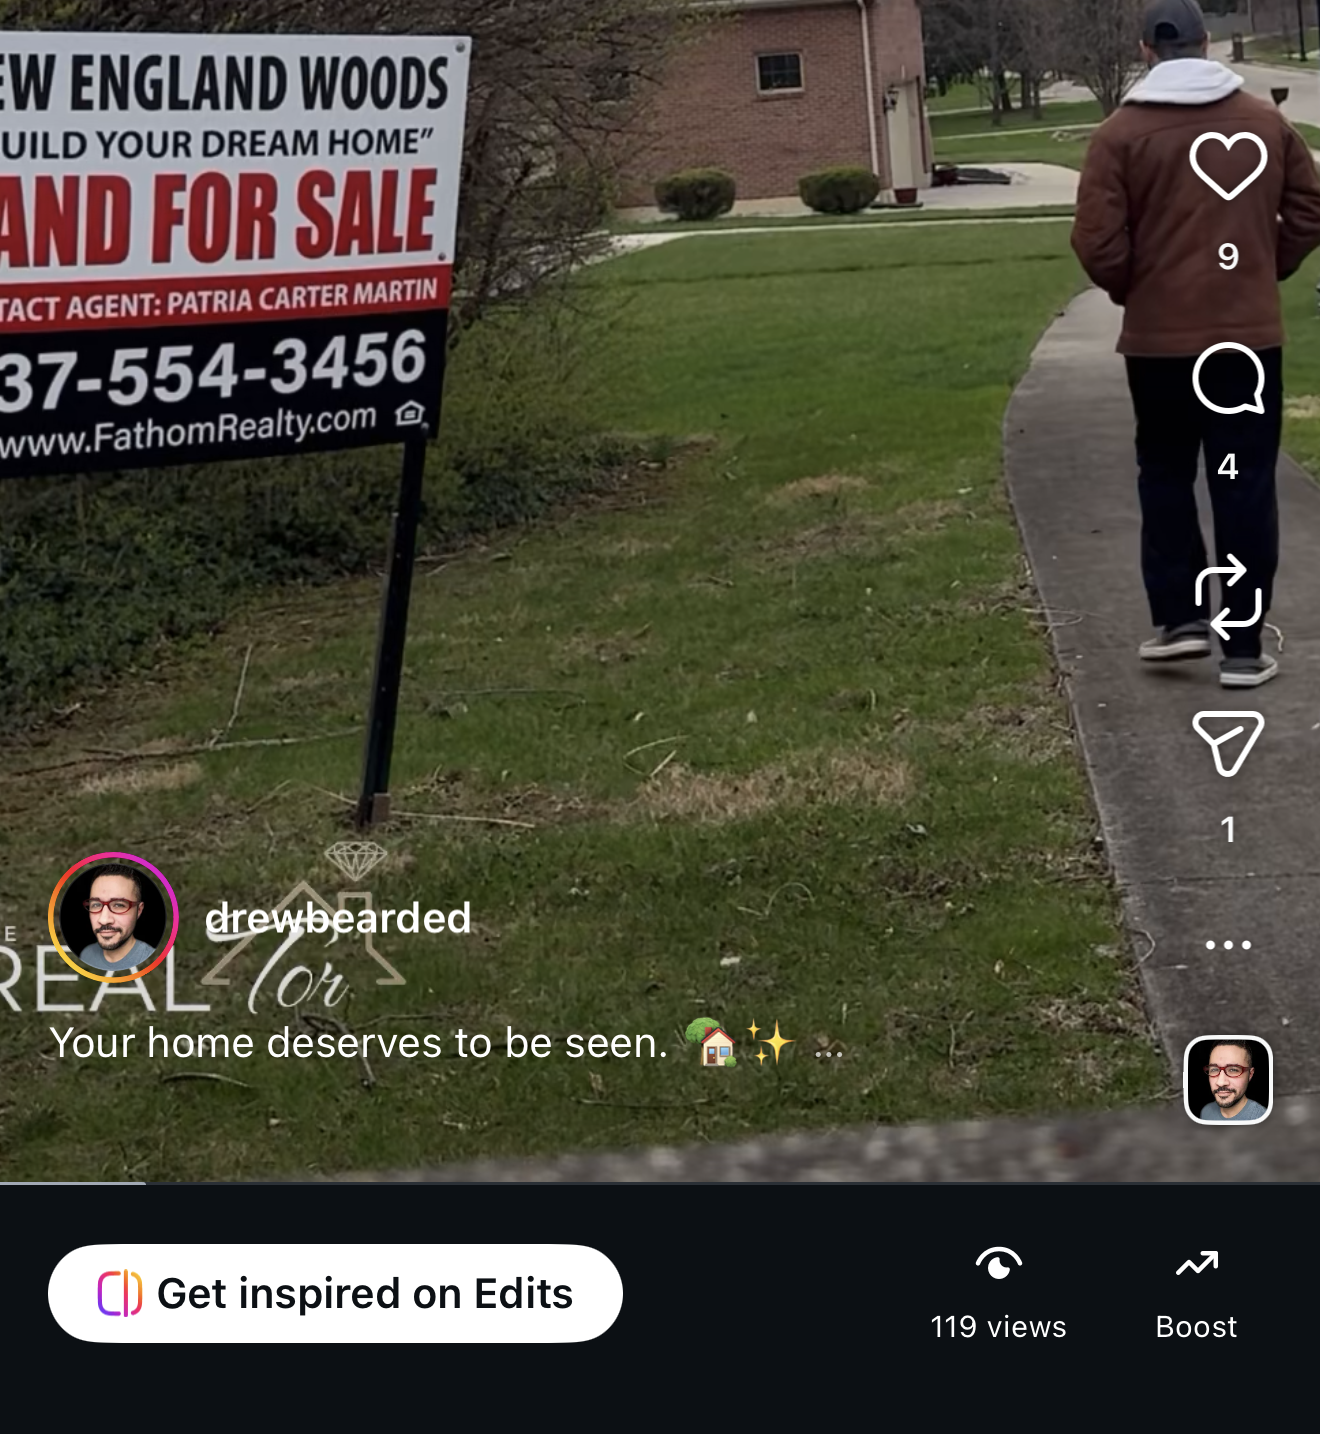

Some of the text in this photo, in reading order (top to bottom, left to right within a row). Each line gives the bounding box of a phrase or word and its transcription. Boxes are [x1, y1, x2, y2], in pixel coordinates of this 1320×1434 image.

[0, 53, 448, 112] W ENGLAND WOODS
[2, 130, 88, 159] UILD
[96, 130, 192, 159] YOUR
[202, 129, 319, 158] DREAM
[0, 167, 438, 268] AND FOR SALE
[65, 292, 162, 321] AGENT:
[167, 288, 253, 315] PATRIA
[259, 283, 348, 310] CARTER
[352, 277, 438, 306] MARTIN
[0, 328, 426, 414] 37-554-3456
[0, 407, 377, 460] www.FathomRealty.com
